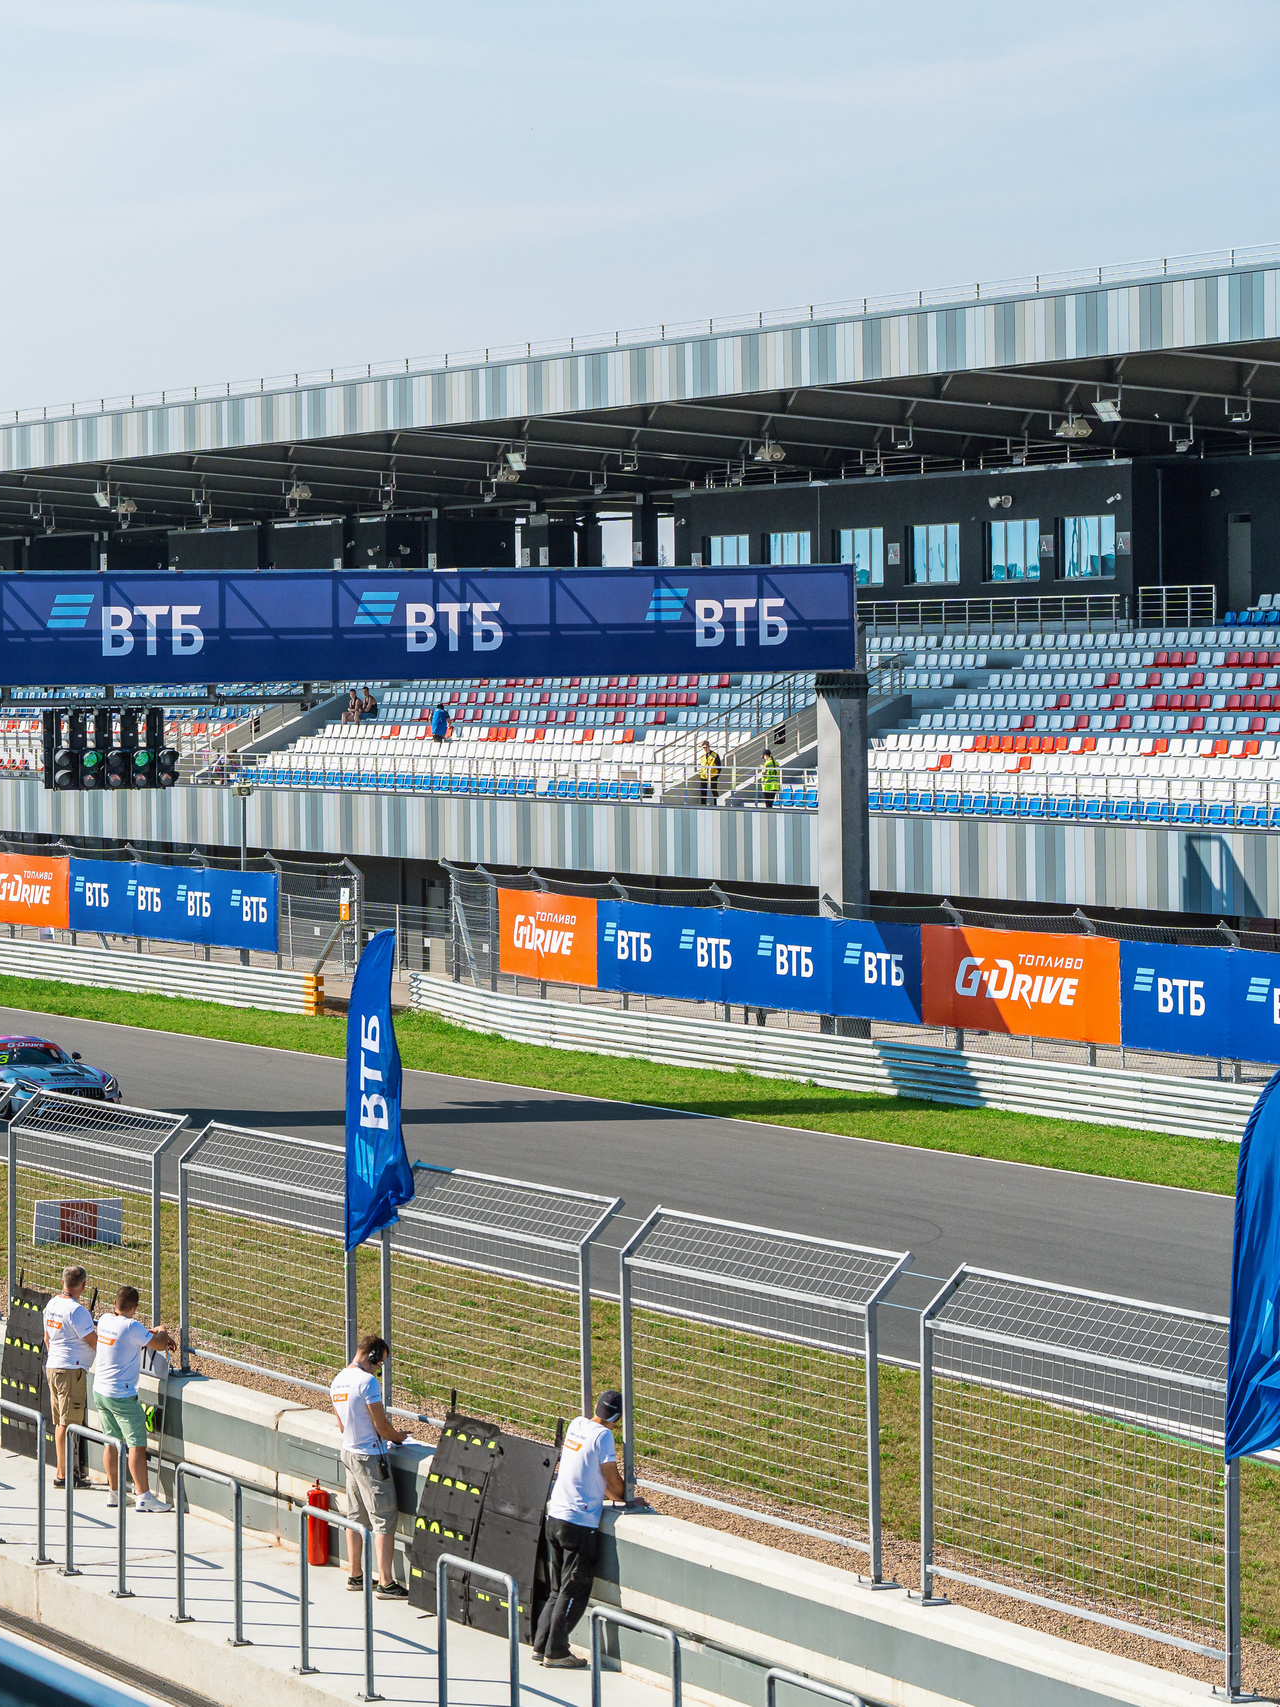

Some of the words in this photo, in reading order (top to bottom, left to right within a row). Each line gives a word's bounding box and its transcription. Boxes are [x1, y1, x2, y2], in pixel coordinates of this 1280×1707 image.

[102, 606, 204, 655] ВТБ
[406, 603, 503, 651] ВТБ
[696, 598, 788, 646] ВТБ
[24, 870, 53, 880] ТОПЛИВО
[86, 883, 109, 907] ВТБ
[138, 886, 161, 912] ВТБ
[188, 891, 211, 917] ВТБ
[243, 896, 267, 922] ВТБ
[536, 912, 576, 925] ТОПЛИВО
[617, 930, 652, 962] ВТБ
[697, 937, 732, 969] ВТБ
[776, 944, 813, 977] ВТБ
[1019, 954, 1083, 969] ТОПЛИВО
[865, 952, 904, 986] ВТБ
[1158, 978, 1205, 1016] ВТБ
[360, 1014, 389, 1130] ВТБ
